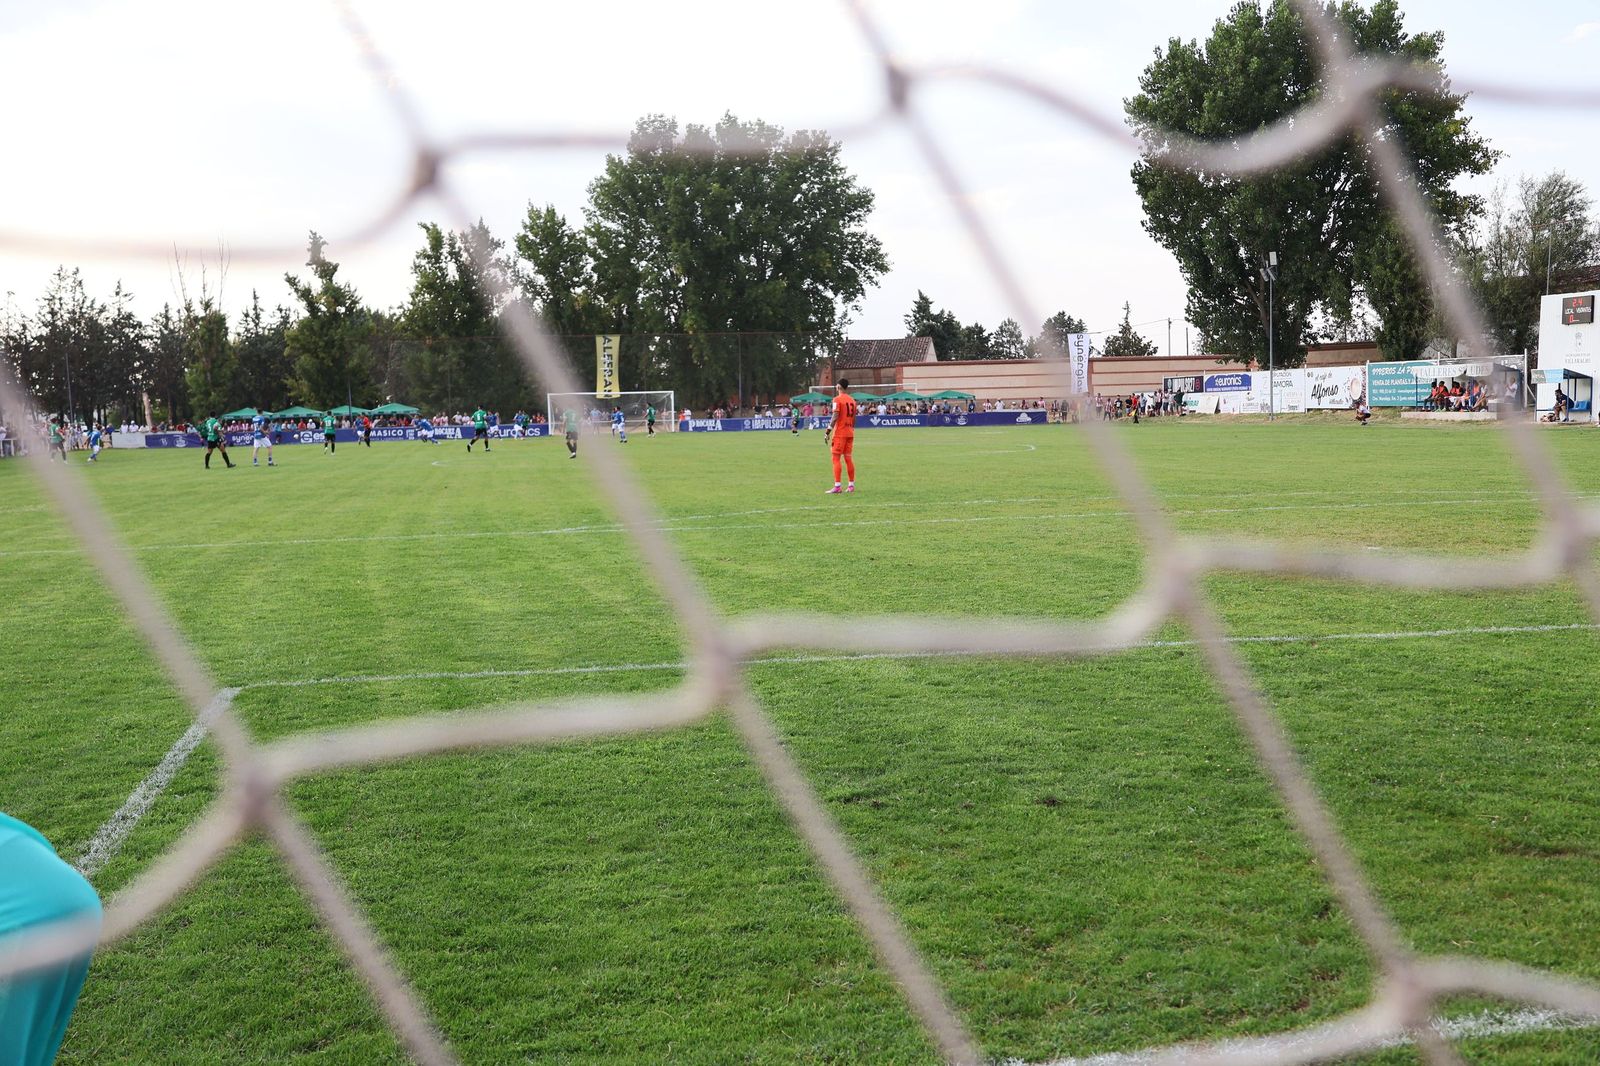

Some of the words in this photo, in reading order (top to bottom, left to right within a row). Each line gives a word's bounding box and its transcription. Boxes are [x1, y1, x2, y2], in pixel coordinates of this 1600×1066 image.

[1218, 376, 1242, 387] euronics
[1311, 384, 1339, 406] Alfonso
[752, 418, 787, 430] IMPULSO27
